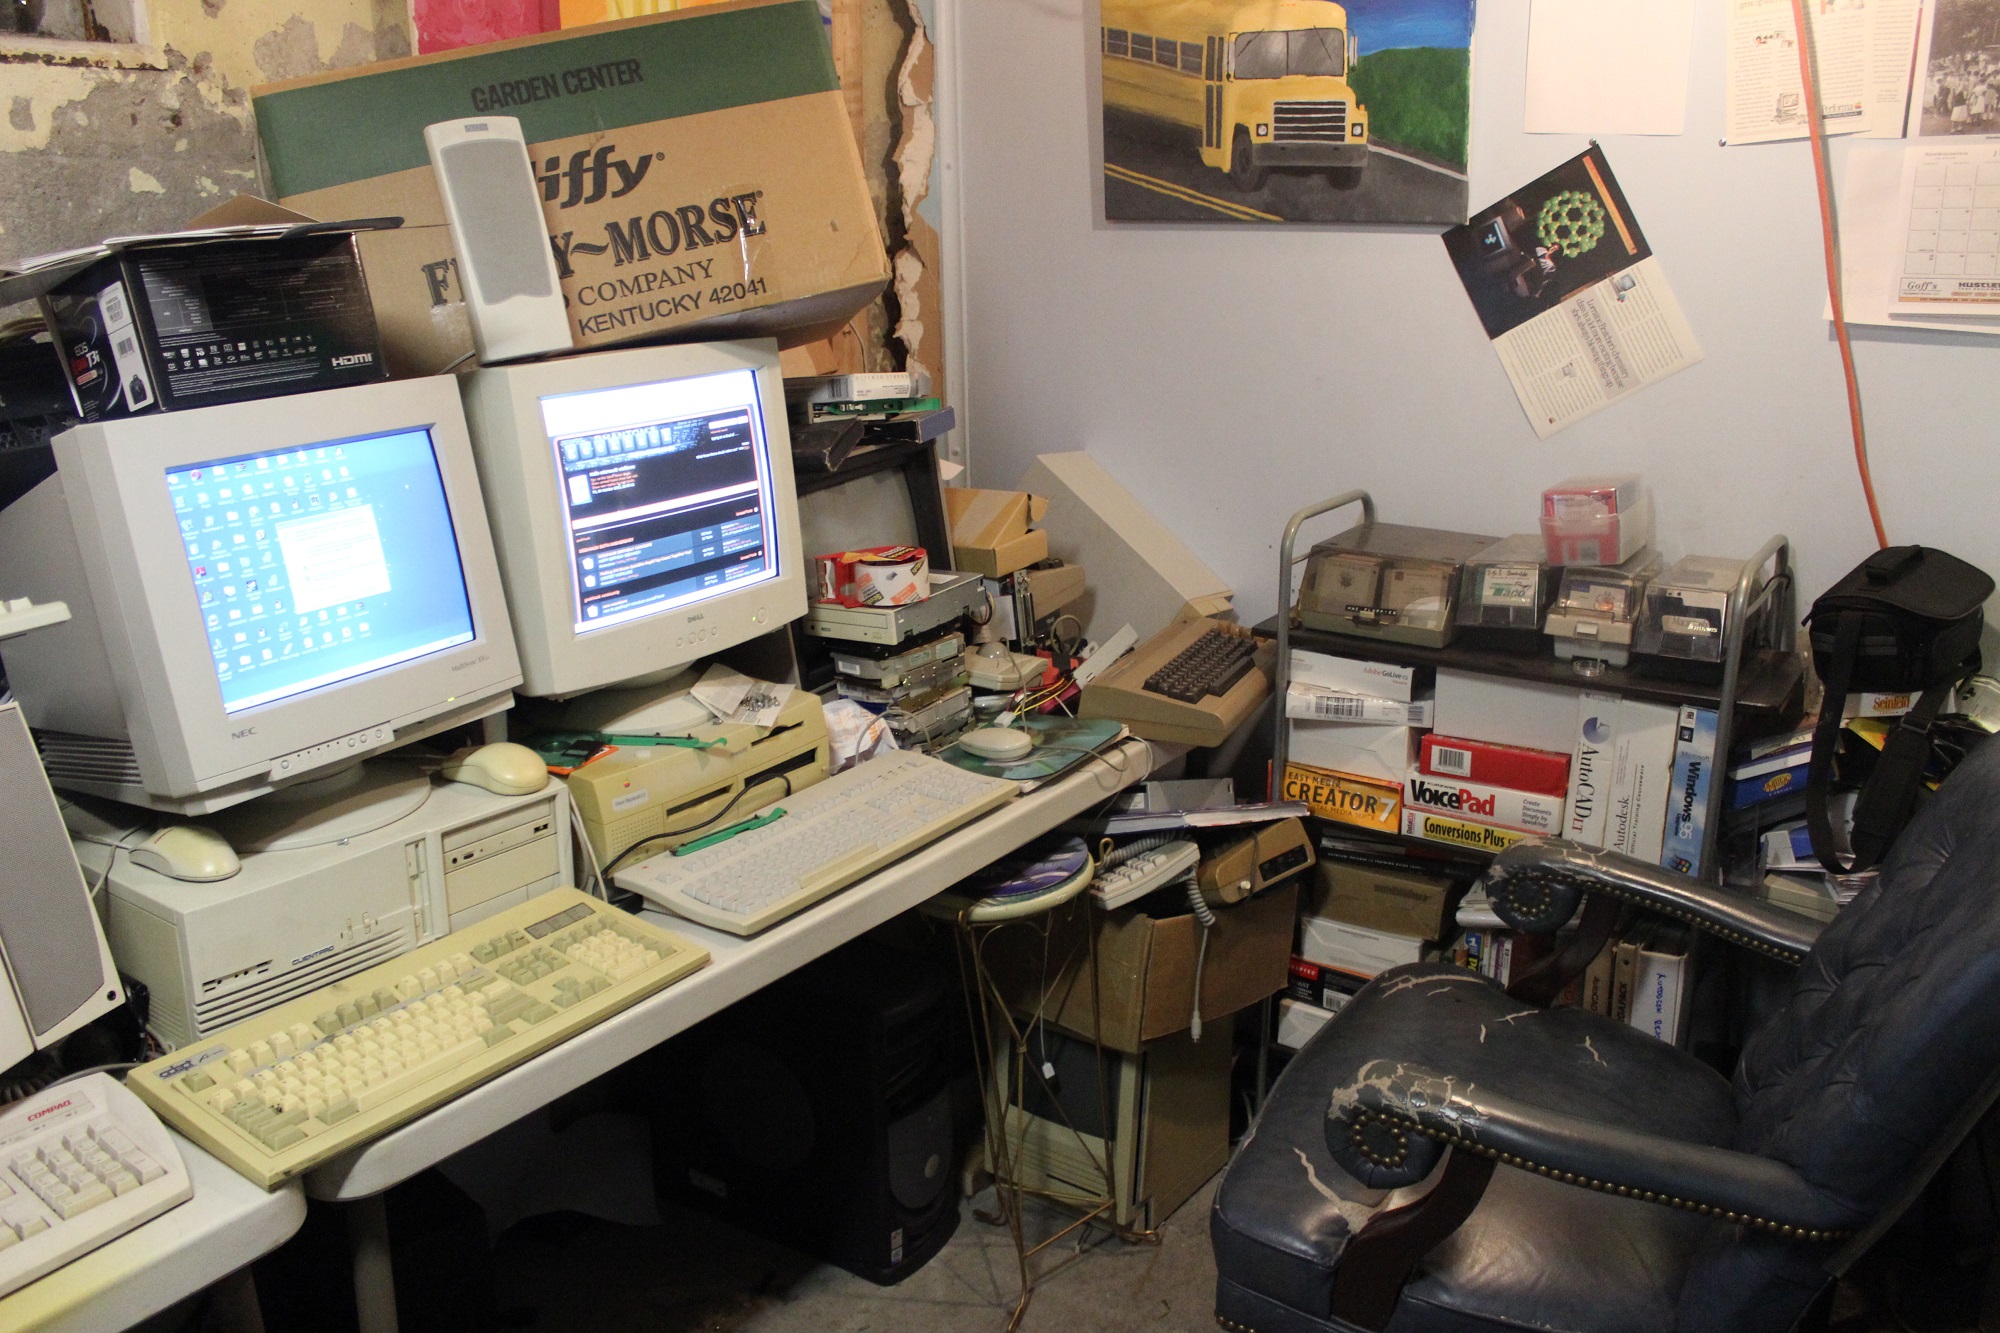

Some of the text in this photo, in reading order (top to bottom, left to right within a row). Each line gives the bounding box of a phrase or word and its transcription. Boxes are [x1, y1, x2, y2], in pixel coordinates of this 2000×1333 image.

[470, 57, 645, 113] GARDEN CENTER
[531, 144, 654, 209] iffy
[577, 258, 714, 307] COMPANY
[1907, 281, 1938, 292] Goff's
[578, 277, 768, 336] KENTUCKY 42041
[332, 352, 374, 367] HDMI
[687, 612, 705, 623] DELL
[1382, 670, 1402, 679] GoLive
[1873, 696, 1910, 711] Seinfeld
[231, 726, 257, 740] NEC
[1288, 771, 1309, 782] EASY
[1574, 743, 1600, 819] AutoCAD
[1286, 781, 1378, 814] CREATOR
[1379, 797, 1397, 823] 7
[1679, 761, 1701, 840] Windows 95
[1331, 806, 1353, 817] MEDIA
[1523, 805, 1551, 816] Documents
[1523, 812, 1540, 820] Simply
[1424, 817, 1482, 844] Conversions
[1484, 828, 1505, 848] Plus
[1613, 797, 1629, 852] Autodesk
[27, 1099, 73, 1122] COMPAQ
